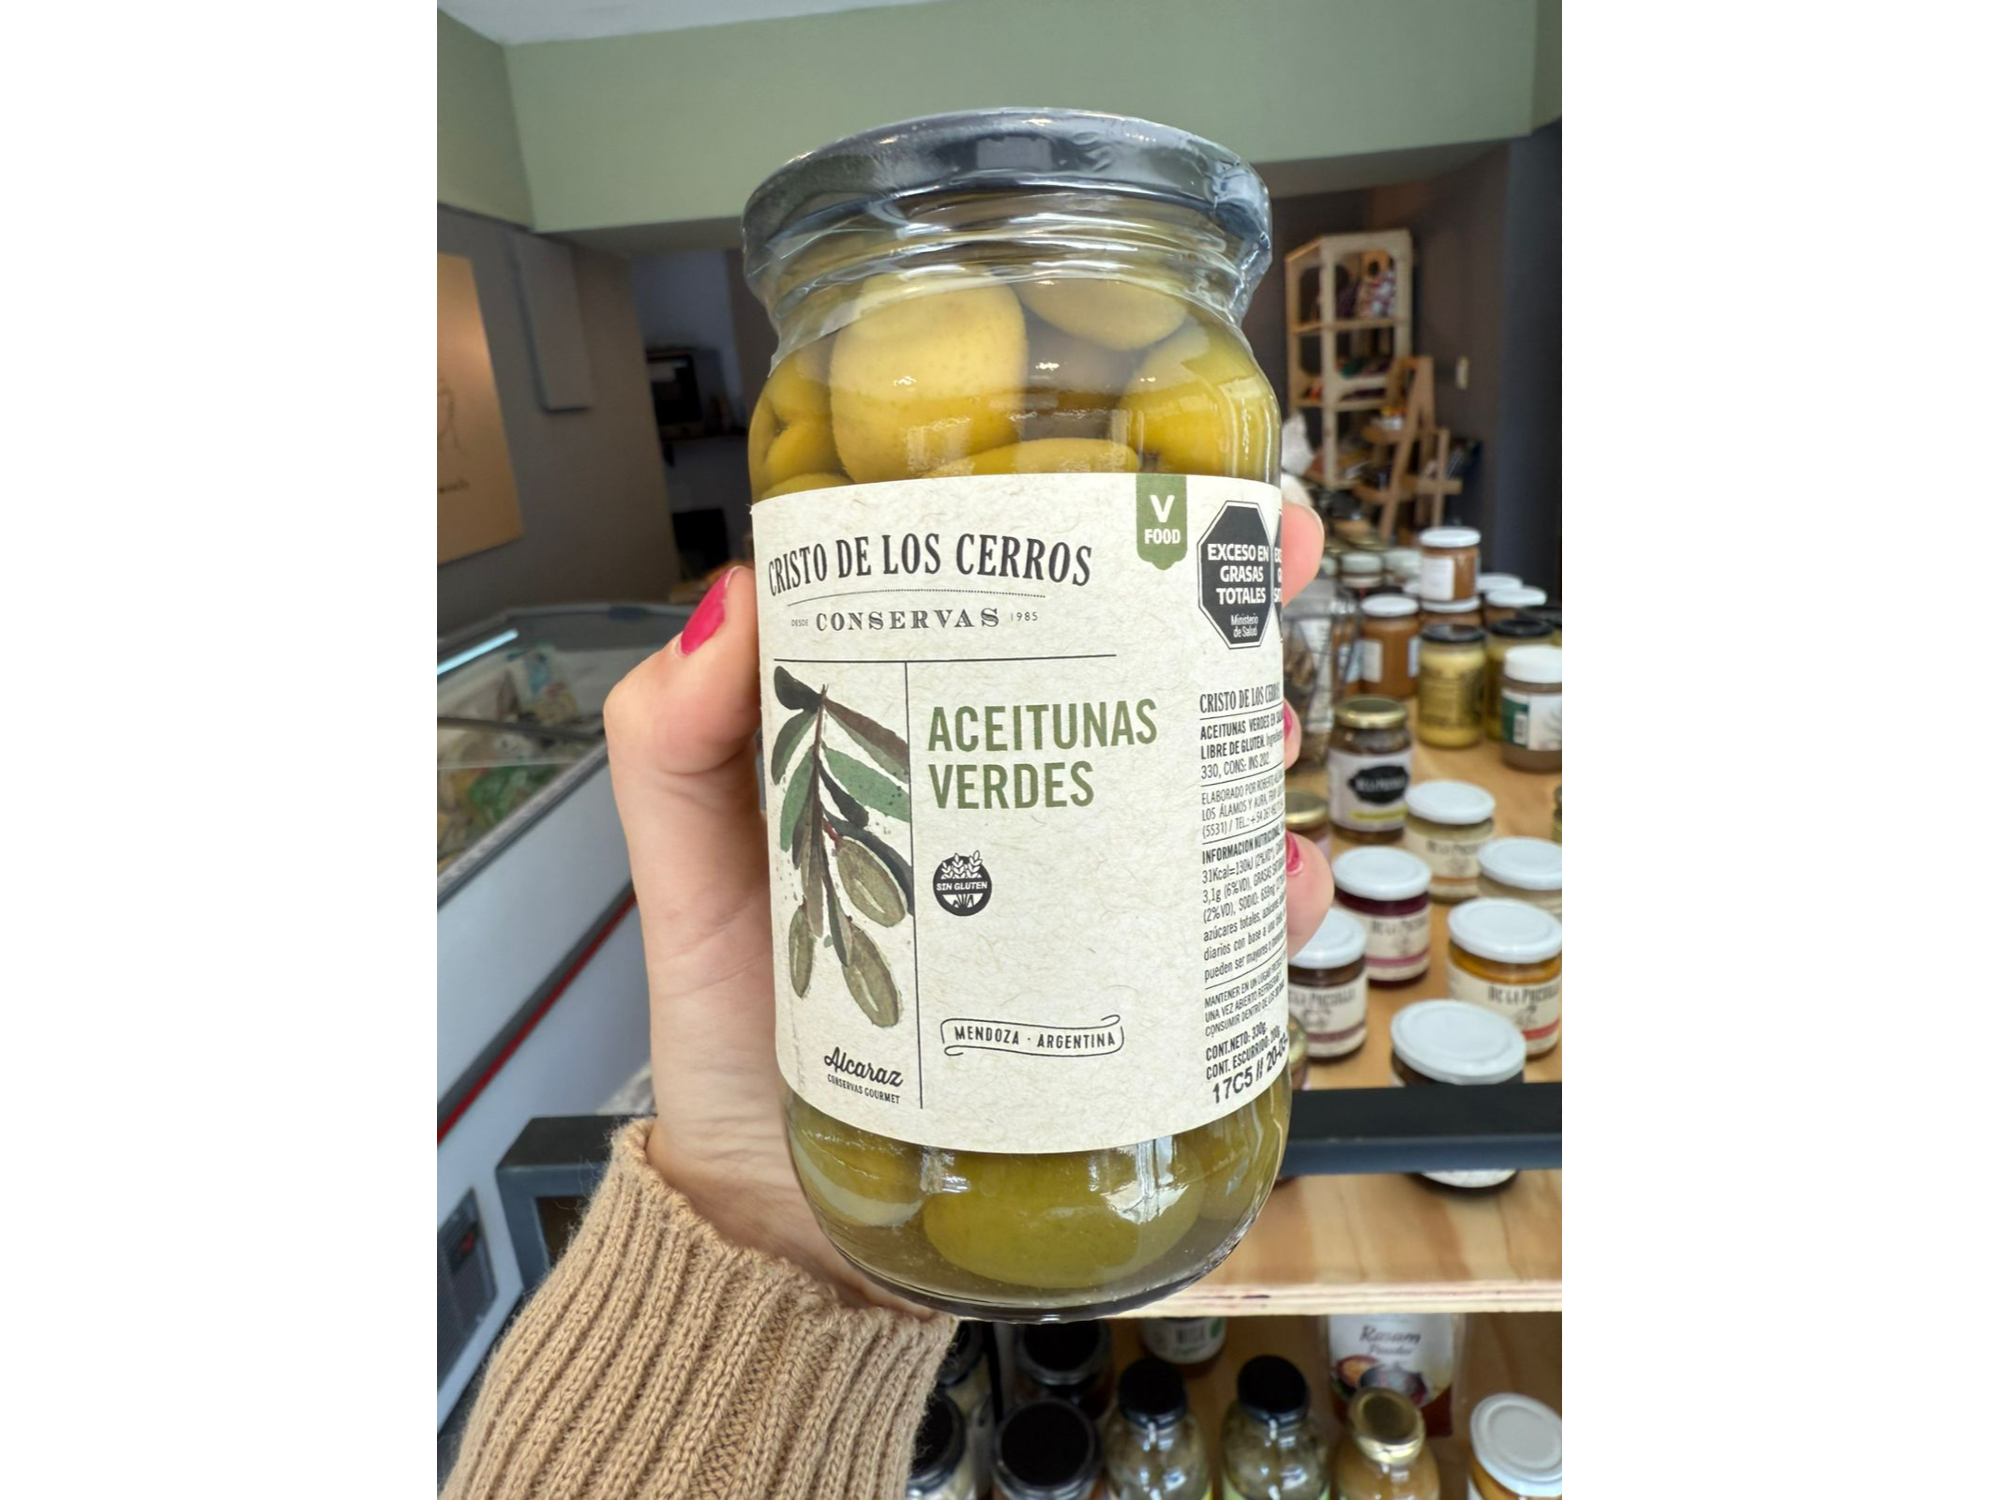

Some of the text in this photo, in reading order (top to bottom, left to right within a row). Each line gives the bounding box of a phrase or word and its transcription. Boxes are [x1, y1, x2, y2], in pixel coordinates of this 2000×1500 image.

[1149, 494, 1176, 523] V
[1144, 528, 1181, 545] FOOD
[1207, 543, 1270, 562] EXCESO EN
[768, 533, 1092, 597] CRISTO DE LOS CERROS
[1219, 565, 1265, 583] GRASAS
[1216, 587, 1267, 605] TOTALES
[790, 618, 810, 627] DESDE
[816, 607, 999, 631] CONSERVAS
[1010, 611, 1039, 622] 1985
[1230, 612, 1259, 626] Ministerio
[1232, 625, 1258, 637] de Salud
[1199, 690, 1238, 714] CRISTO
[1238, 688, 1250, 709] DE
[1251, 686, 1265, 707] LOS
[927, 698, 1158, 752] ACEITUNAS
[1200, 720, 1246, 740] ACEITUNAS
[1248, 714, 1270, 732] VERDES
[1200, 742, 1228, 760] LIBRE
[1229, 740, 1240, 756] DE
[1200, 763, 1222, 780] 330,
[928, 760, 1095, 810] VERDES
[1201, 785, 1243, 805] ELABORADO
[1244, 781, 1256, 796] POR
[1201, 807, 1216, 822] LOS
[1219, 799, 1247, 818] ÁLAMOS
[1248, 798, 1253, 811] Y
[1202, 820, 1228, 839] (5531)
[1202, 838, 1254, 864] INFORMACION
[936, 880, 988, 892] SIN GLUTEN
[1202, 887, 1222, 906] 3,1g
[1203, 922, 1238, 943] azúcares
[1203, 942, 1231, 961] diarios
[1233, 937, 1246, 951] con
[1247, 928, 1262, 945] base
[1204, 961, 1233, 984] pueden
[1234, 955, 1245, 970] ser
[1204, 985, 1241, 1009] MANTENER
[1241, 981, 1250, 994] EN
[1204, 1008, 1221, 1023] UNA
[1221, 1002, 1234, 1017] VEZ
[1234, 991, 1257, 1011] ABIERTO
[1204, 1013, 1241, 1037] CONSUMIR
[954, 1025, 1116, 1050] MENDOZA ARGENTINA
[823, 1046, 904, 1088] Alcaraz
[1206, 1059, 1231, 1081] CONT.
[827, 1073, 901, 1105] CONSERVAS GOURMET
[1212, 1065, 1253, 1104] 17C5
